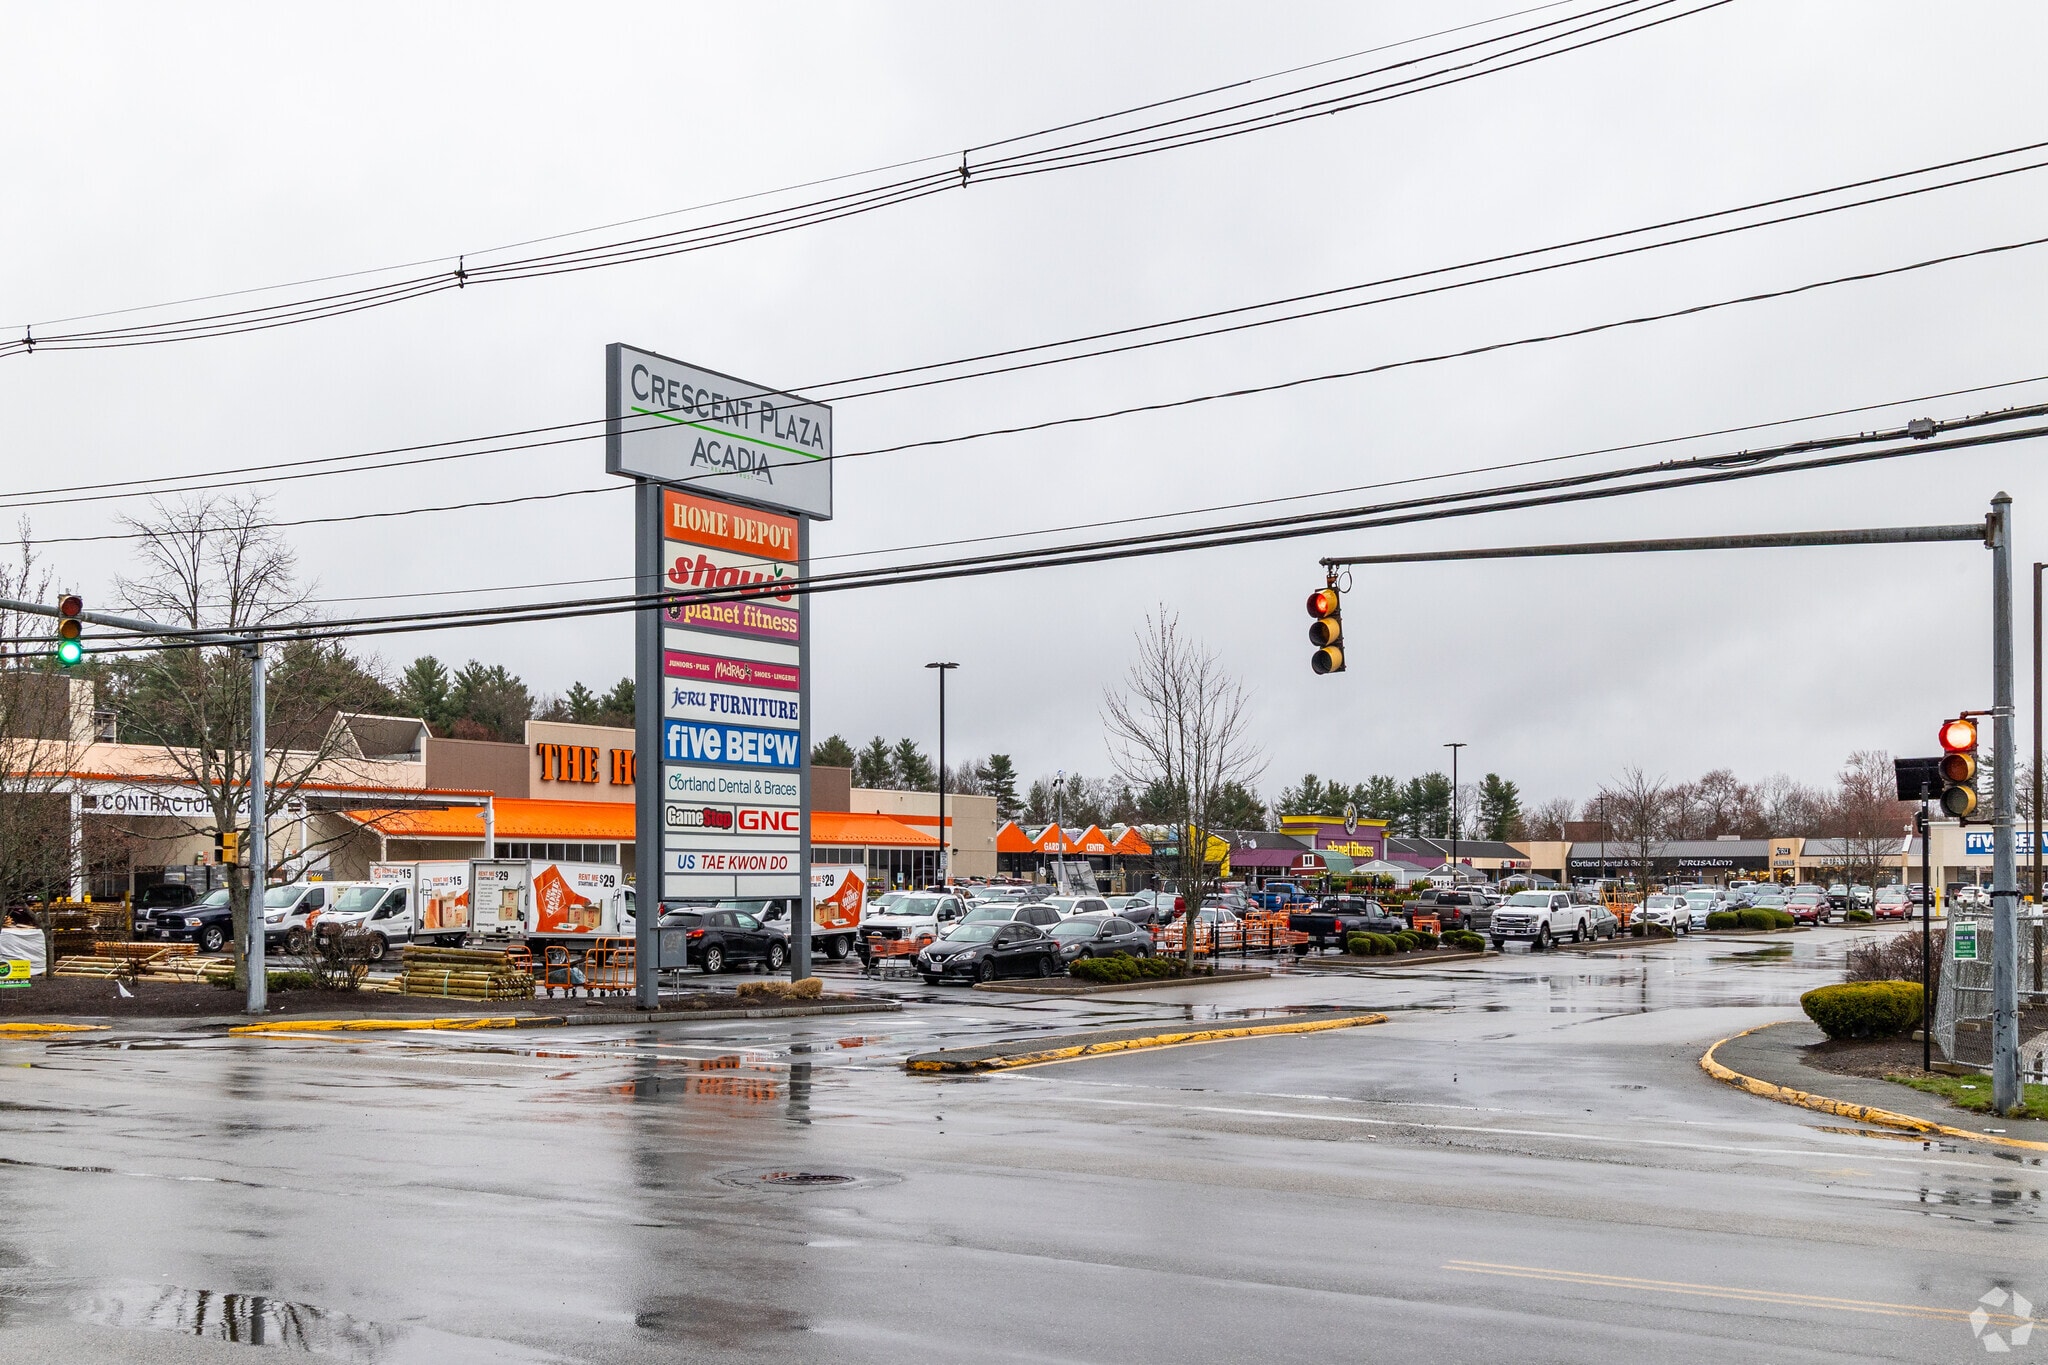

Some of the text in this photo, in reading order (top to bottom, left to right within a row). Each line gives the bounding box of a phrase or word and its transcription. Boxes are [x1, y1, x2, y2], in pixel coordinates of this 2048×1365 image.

[631, 364, 824, 450] CRESCENT PLAZA
[690, 437, 773, 485] ACADIA
[672, 502, 792, 550] HOME DEPOT
[743, 605, 797, 633] fitness
[709, 693, 798, 720] FURNITURE
[537, 743, 600, 784] THE
[668, 774, 797, 796] Cortland Dental & Braces
[666, 805, 733, 830] GameStop
[738, 810, 799, 831] GNC
[1043, 842, 1105, 852] GARDN CENTER
[677, 854, 788, 870] US TAE KWON DO
[1571, 859, 1600, 867] Cortland
[449, 875, 462, 886] $15
[495, 870, 509, 881] $29
[599, 874, 615, 888] $29
[822, 874, 835, 887] $29
